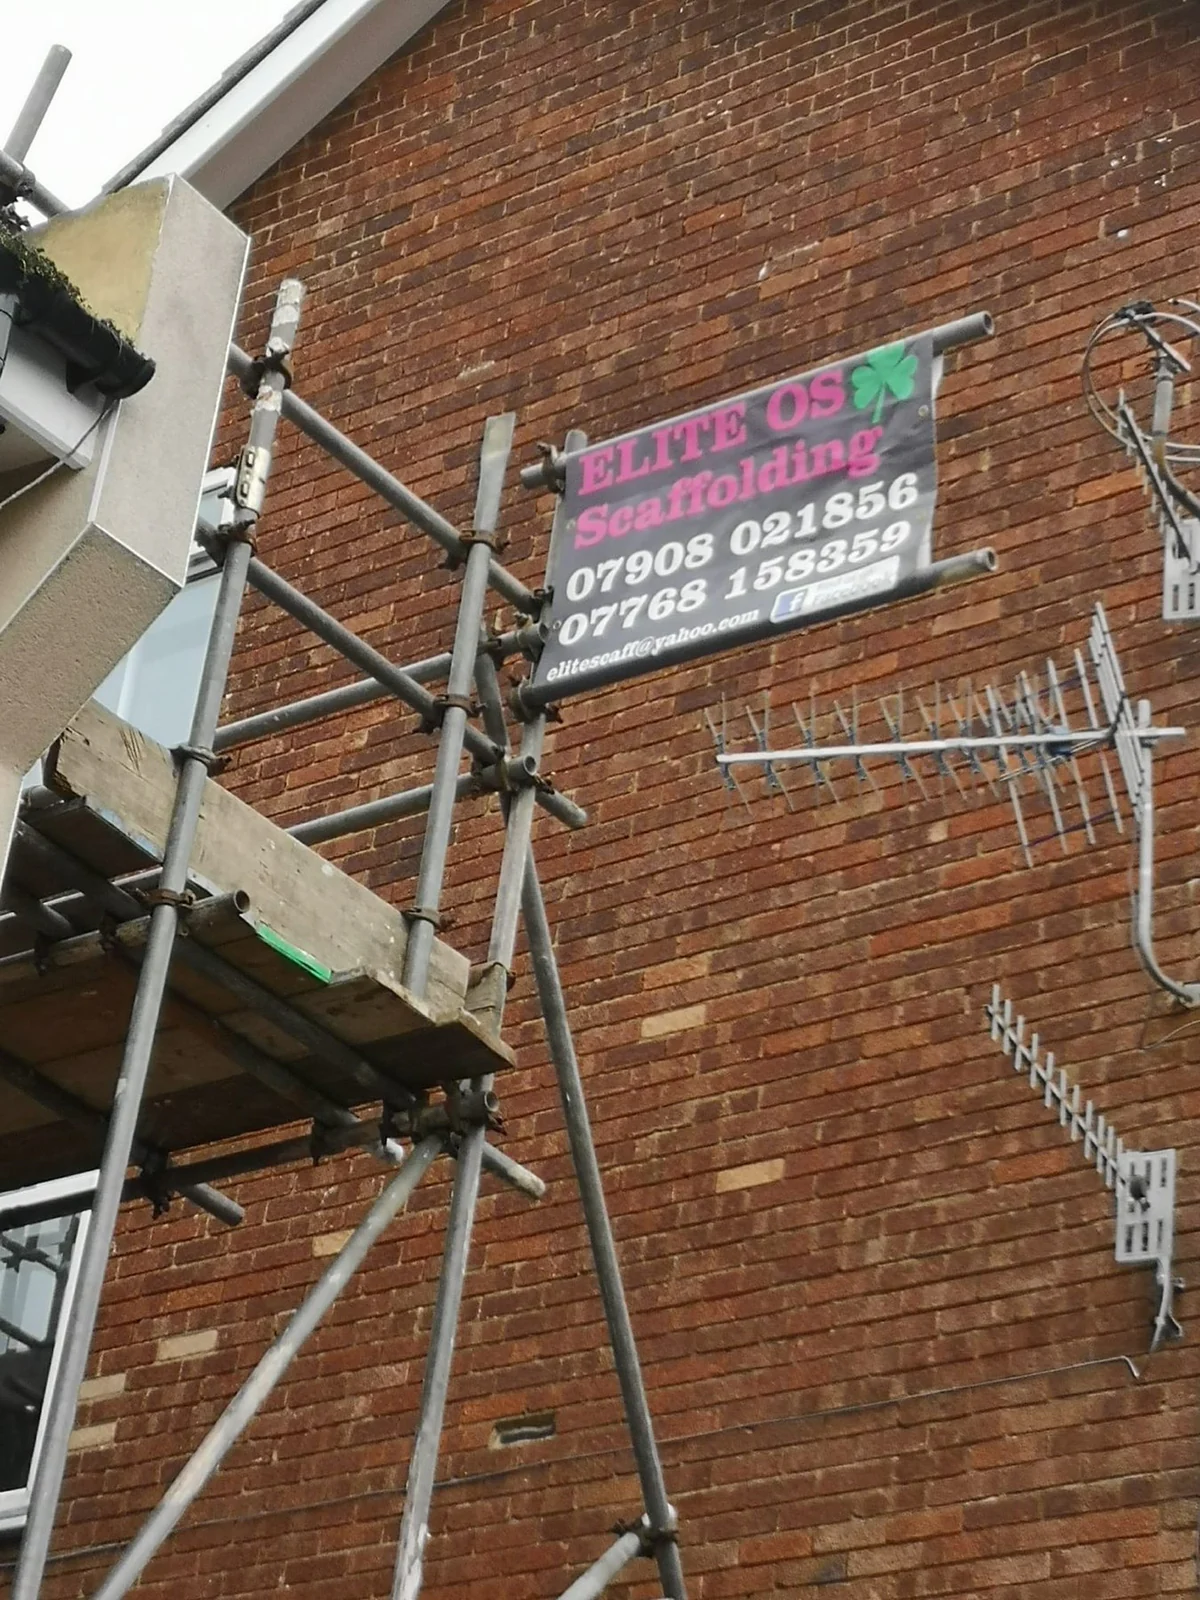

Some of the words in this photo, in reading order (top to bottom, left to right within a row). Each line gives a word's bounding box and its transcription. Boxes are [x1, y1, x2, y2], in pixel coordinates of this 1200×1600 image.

[574, 427, 884, 549] Scaffolding
[577, 403, 747, 496] ELITE
[766, 368, 846, 431] OS
[558, 579, 708, 646] 07768
[724, 520, 912, 599] 158359
[566, 533, 715, 602] 07908
[729, 472, 919, 556] 021856
[546, 607, 759, 681] elitescaff@yahoo.com
